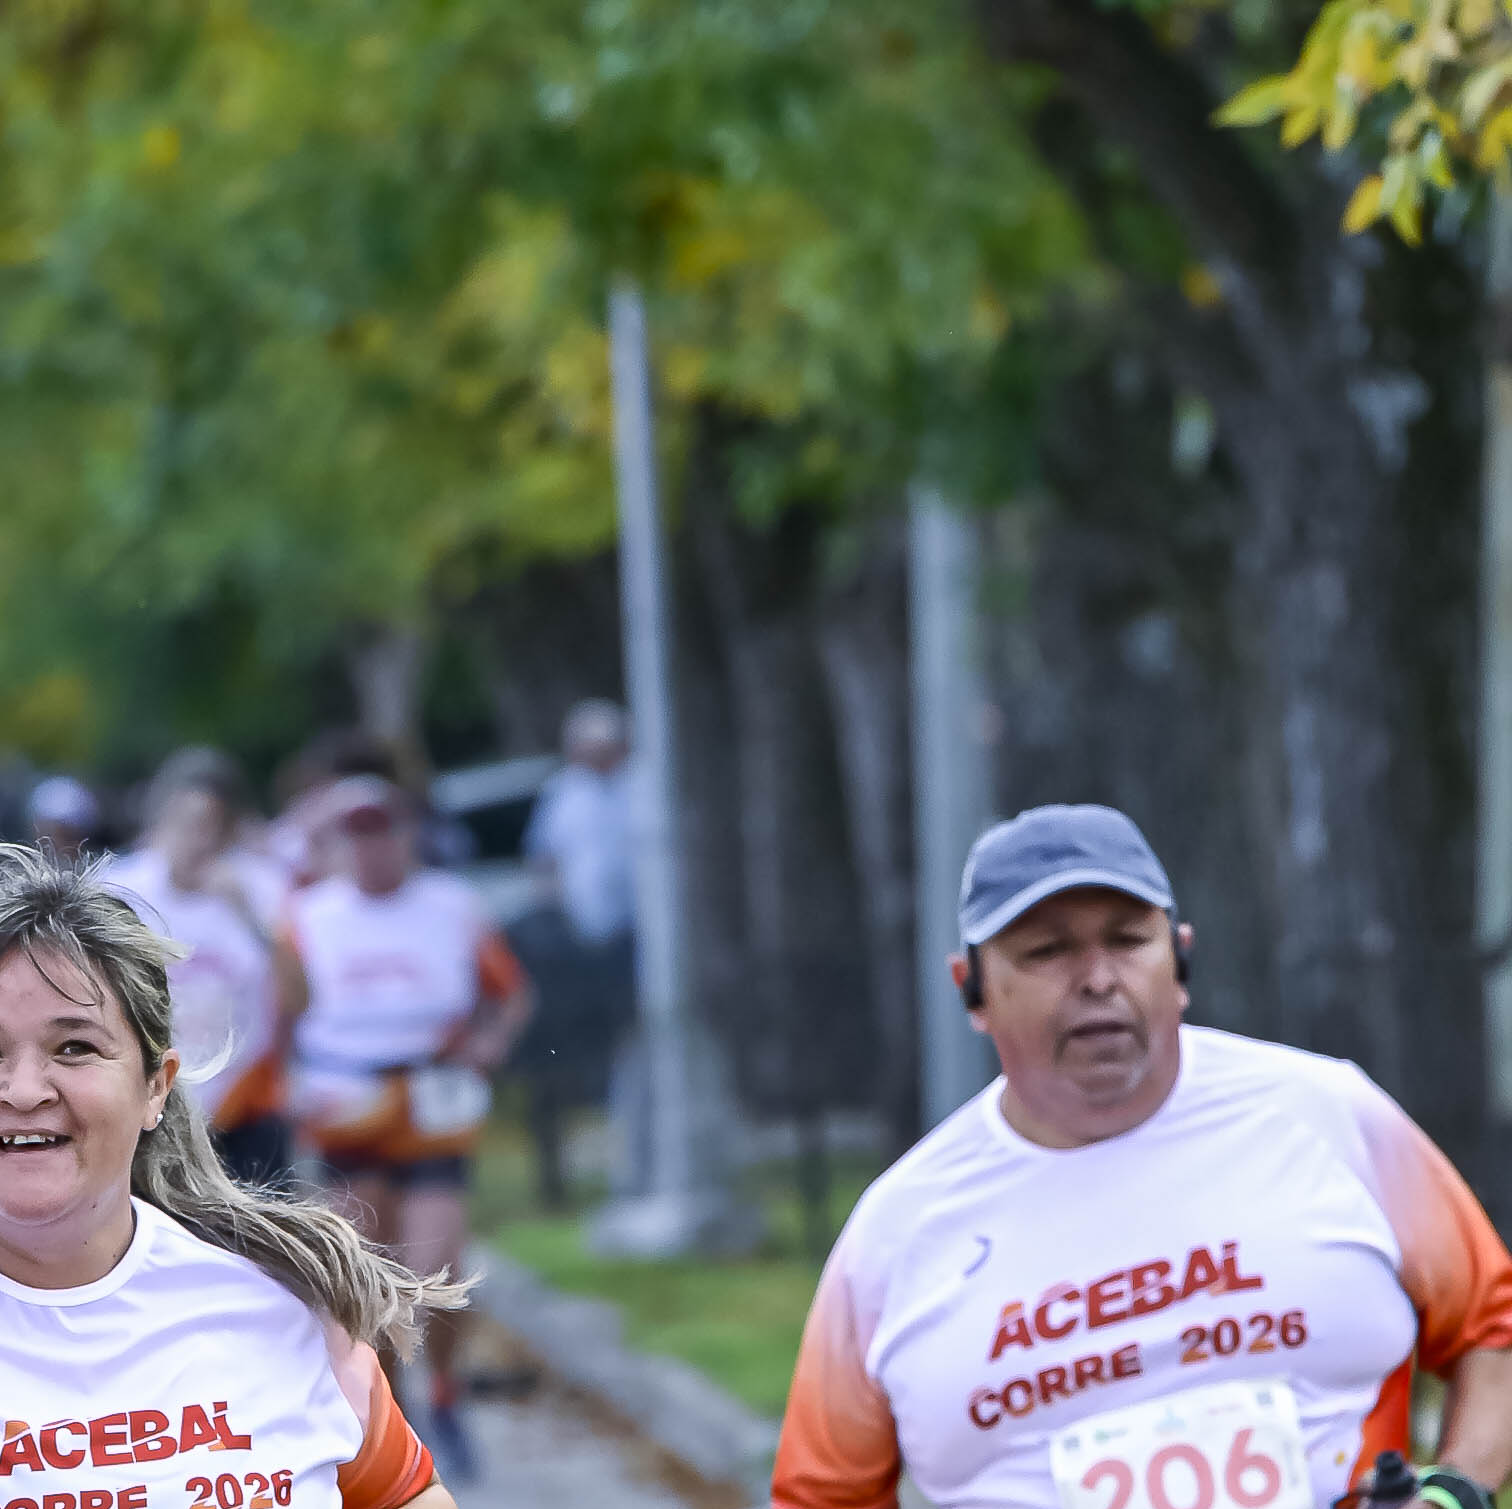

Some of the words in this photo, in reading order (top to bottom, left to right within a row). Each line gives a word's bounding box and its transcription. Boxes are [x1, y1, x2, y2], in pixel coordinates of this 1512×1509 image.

[990, 1241, 1263, 1360] ACEBAL
[969, 1344, 1142, 1430] CORRE
[1179, 1311, 1307, 1365] 2026
